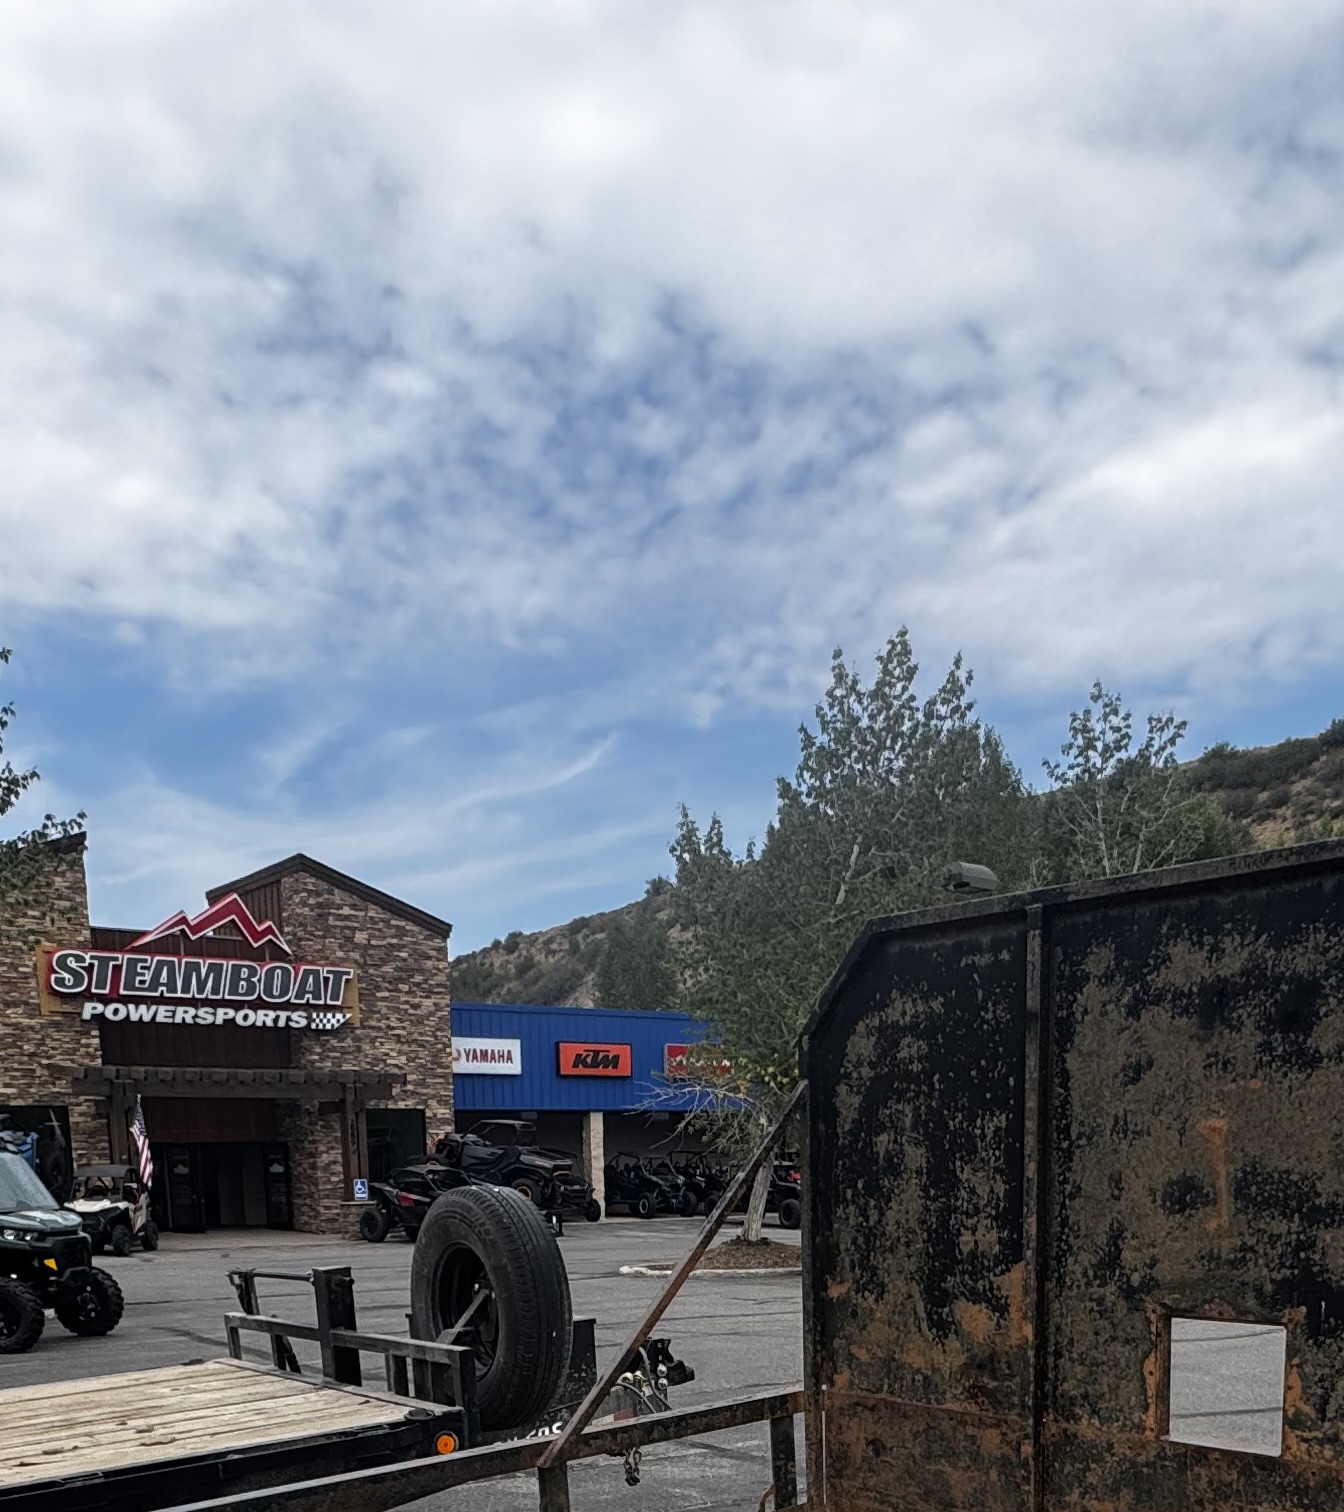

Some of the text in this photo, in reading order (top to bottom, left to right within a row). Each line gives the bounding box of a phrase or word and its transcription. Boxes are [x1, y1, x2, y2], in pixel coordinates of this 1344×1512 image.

[51, 950, 353, 1006] STEAMBOAT
[82, 1002, 308, 1030] POWERSPORTS
[463, 1048, 514, 1065] YAMAHA
[571, 1049, 621, 1070] KTM
